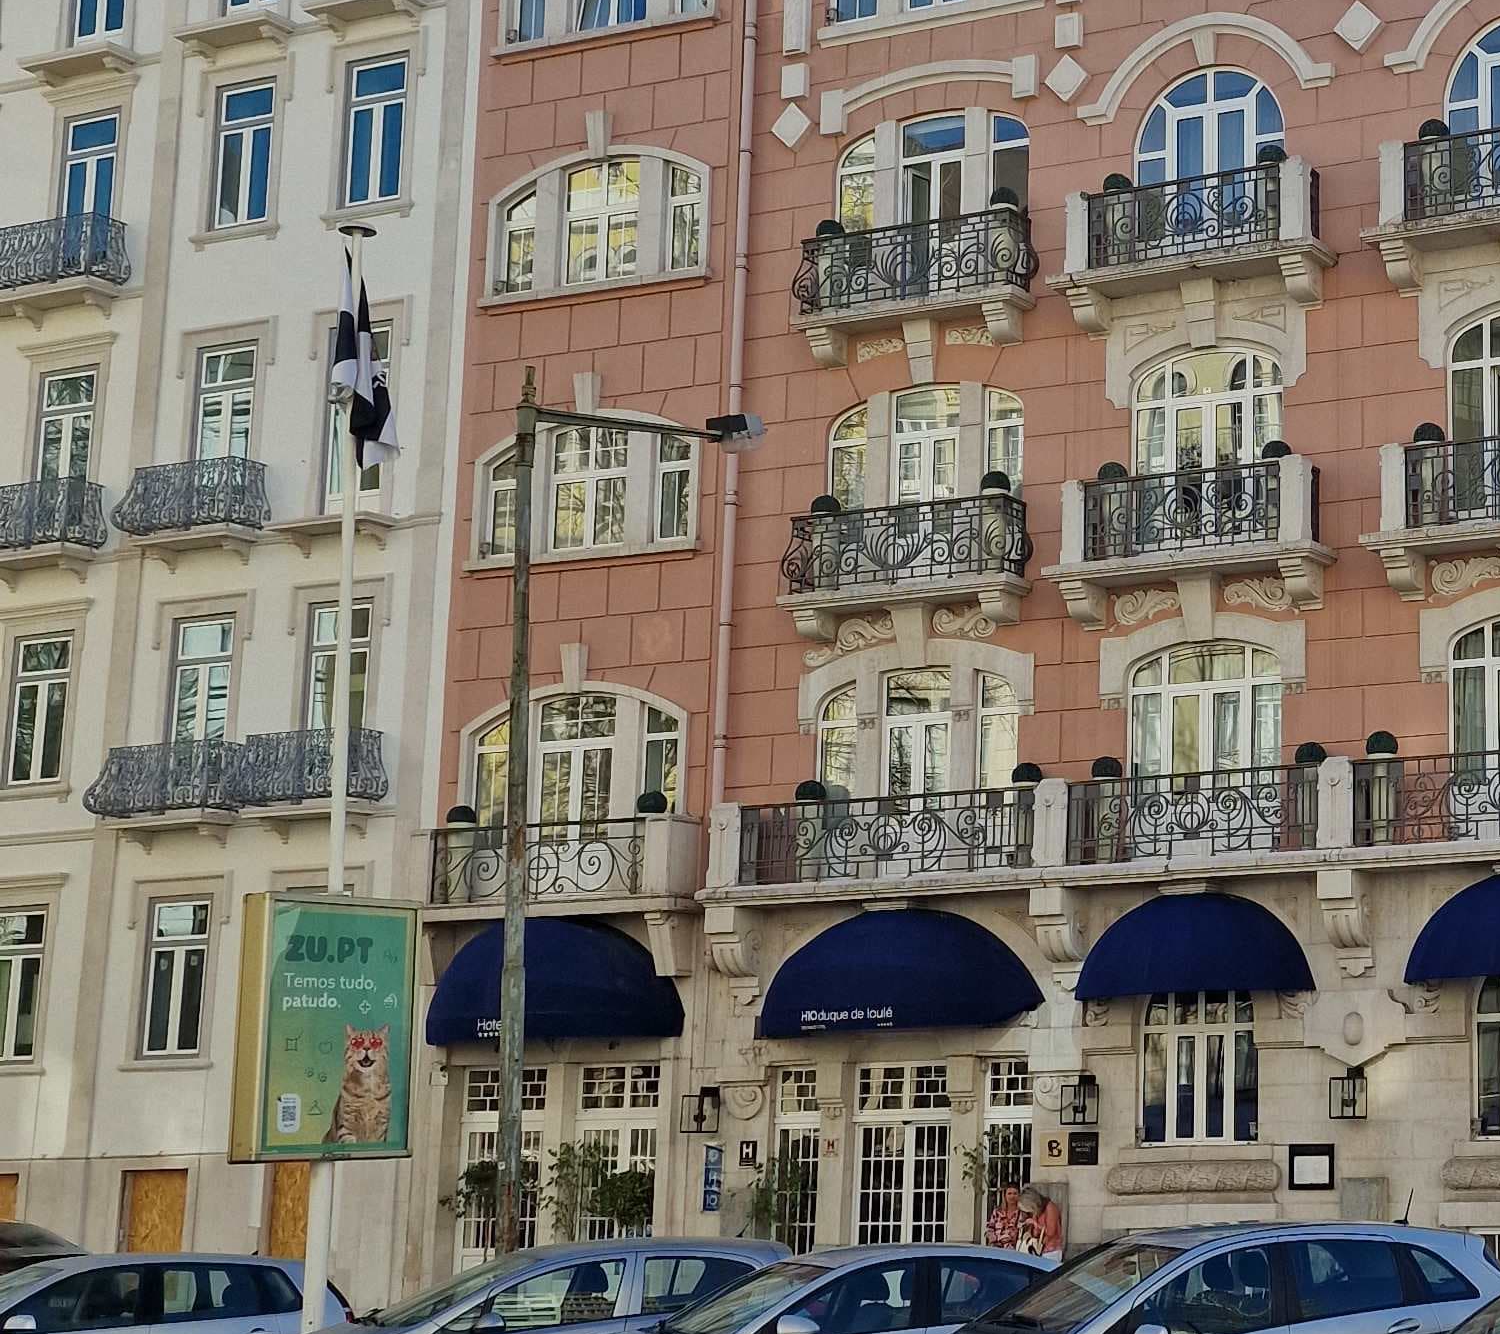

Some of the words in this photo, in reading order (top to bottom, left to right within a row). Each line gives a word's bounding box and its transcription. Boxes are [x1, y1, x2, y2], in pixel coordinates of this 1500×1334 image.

[285, 934, 373, 964] ZU.PT
[283, 972, 336, 989] Temos
[340, 975, 377, 994] tudo,
[282, 993, 341, 1012] patudo.
[850, 1007, 864, 1020] de
[867, 1006, 893, 1019] loulé
[477, 1018, 502, 1031] Hote
[742, 1142, 753, 1159] H
